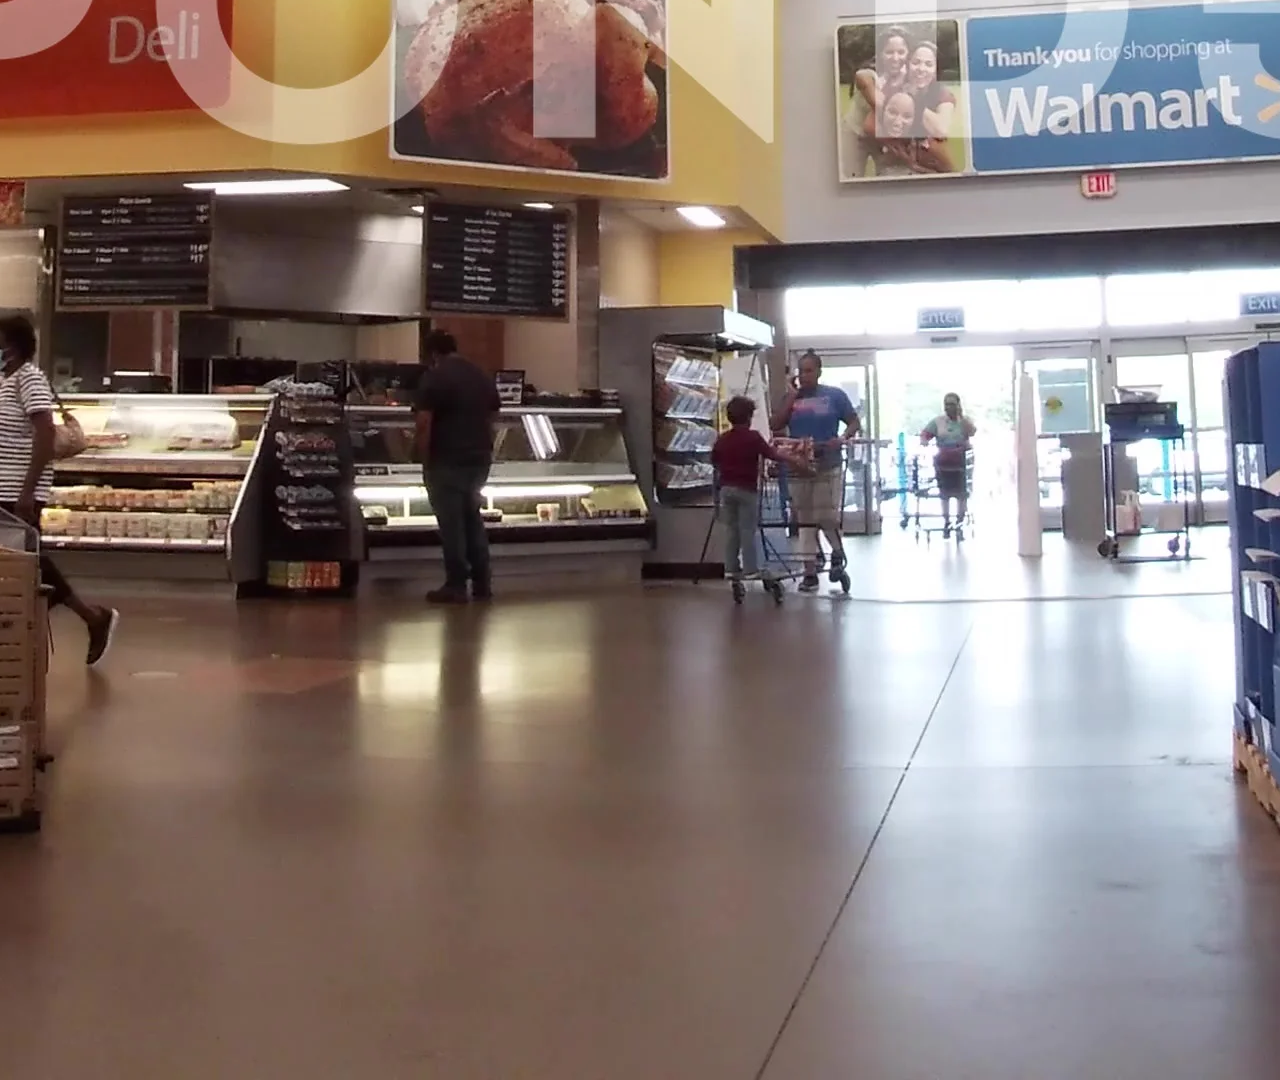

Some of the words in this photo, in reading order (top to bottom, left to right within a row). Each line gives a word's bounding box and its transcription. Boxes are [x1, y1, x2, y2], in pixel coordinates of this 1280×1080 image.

[108, 10, 200, 64] Deli
[984, 45, 1050, 68] Thank
[1051, 47, 1091, 68] you
[1094, 42, 1119, 61] for
[1122, 39, 1211, 65] shopping
[1214, 38, 1232, 55] at
[984, 75, 1243, 139] Walmart
[1248, 295, 1278, 311] Exit
